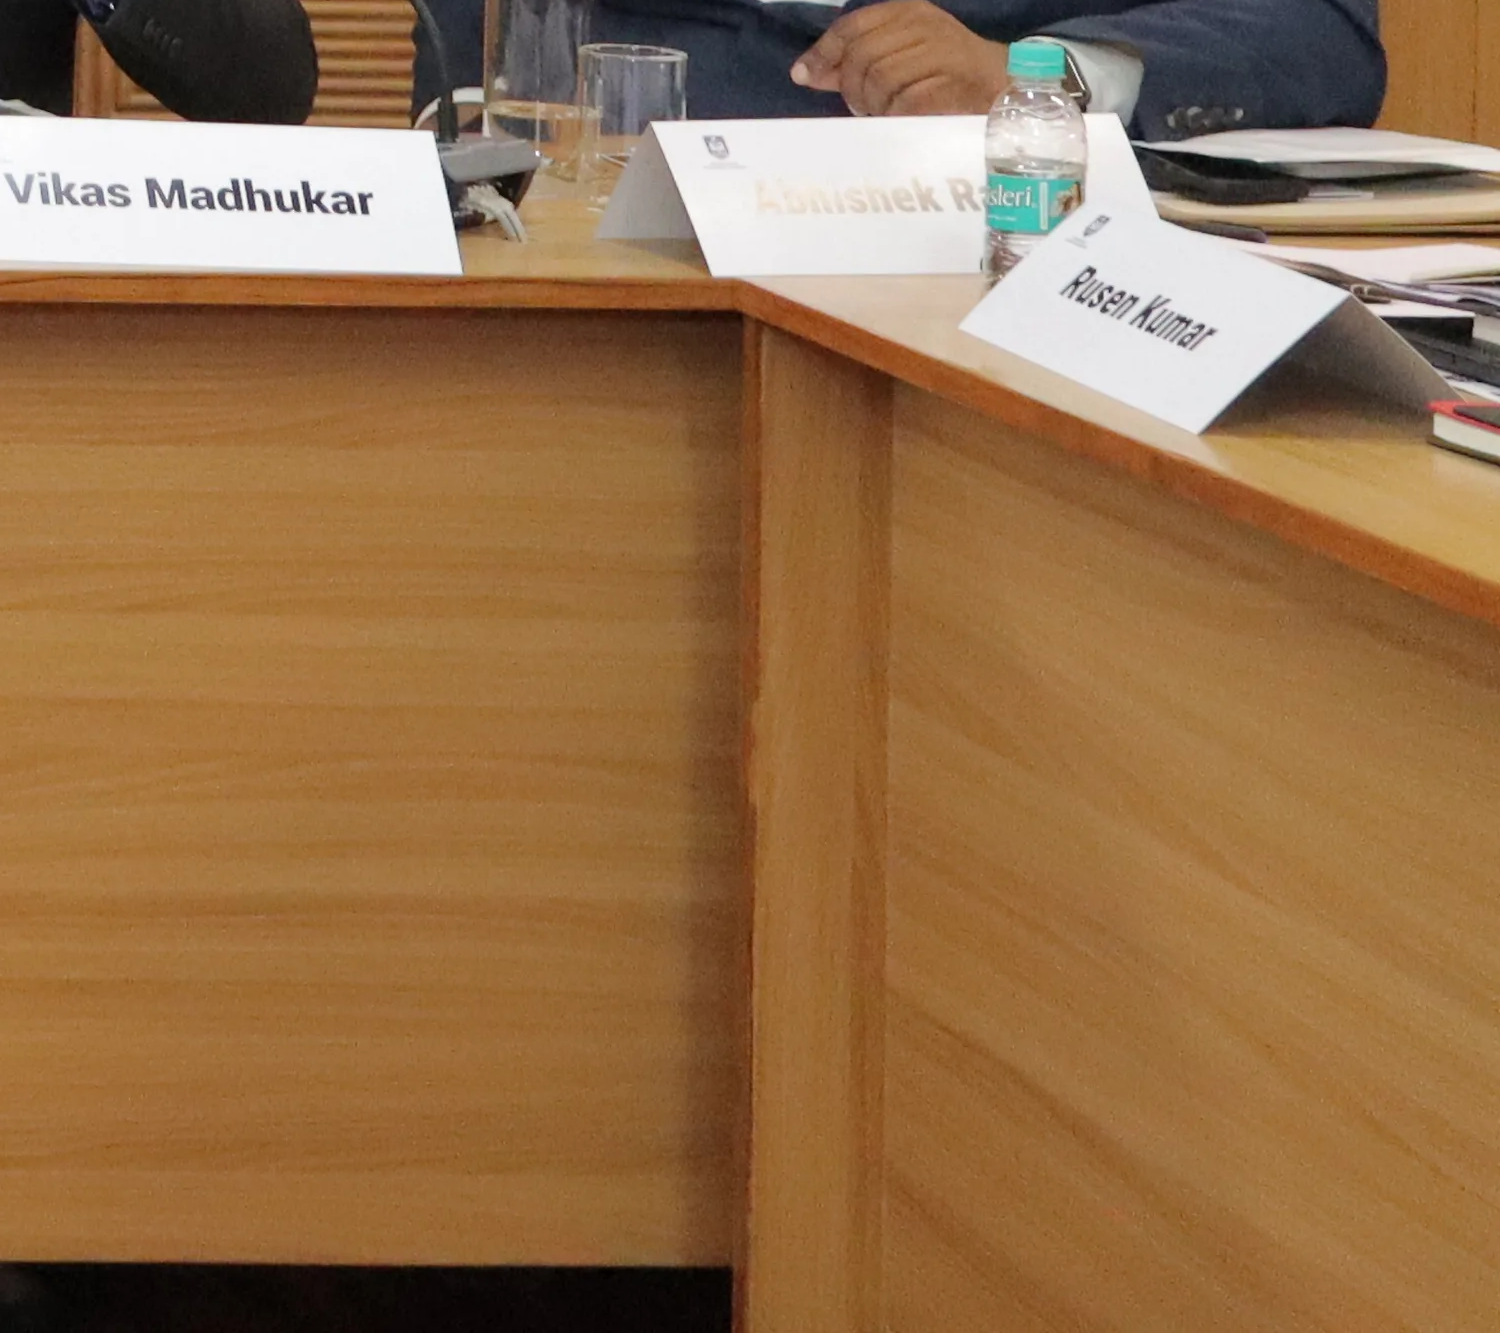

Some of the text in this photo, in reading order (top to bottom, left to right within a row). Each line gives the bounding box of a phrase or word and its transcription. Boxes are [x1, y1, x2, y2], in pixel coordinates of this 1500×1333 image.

[3, 171, 374, 216] Vikas Madhukar
[1058, 264, 1219, 352] Rusen Kumar
